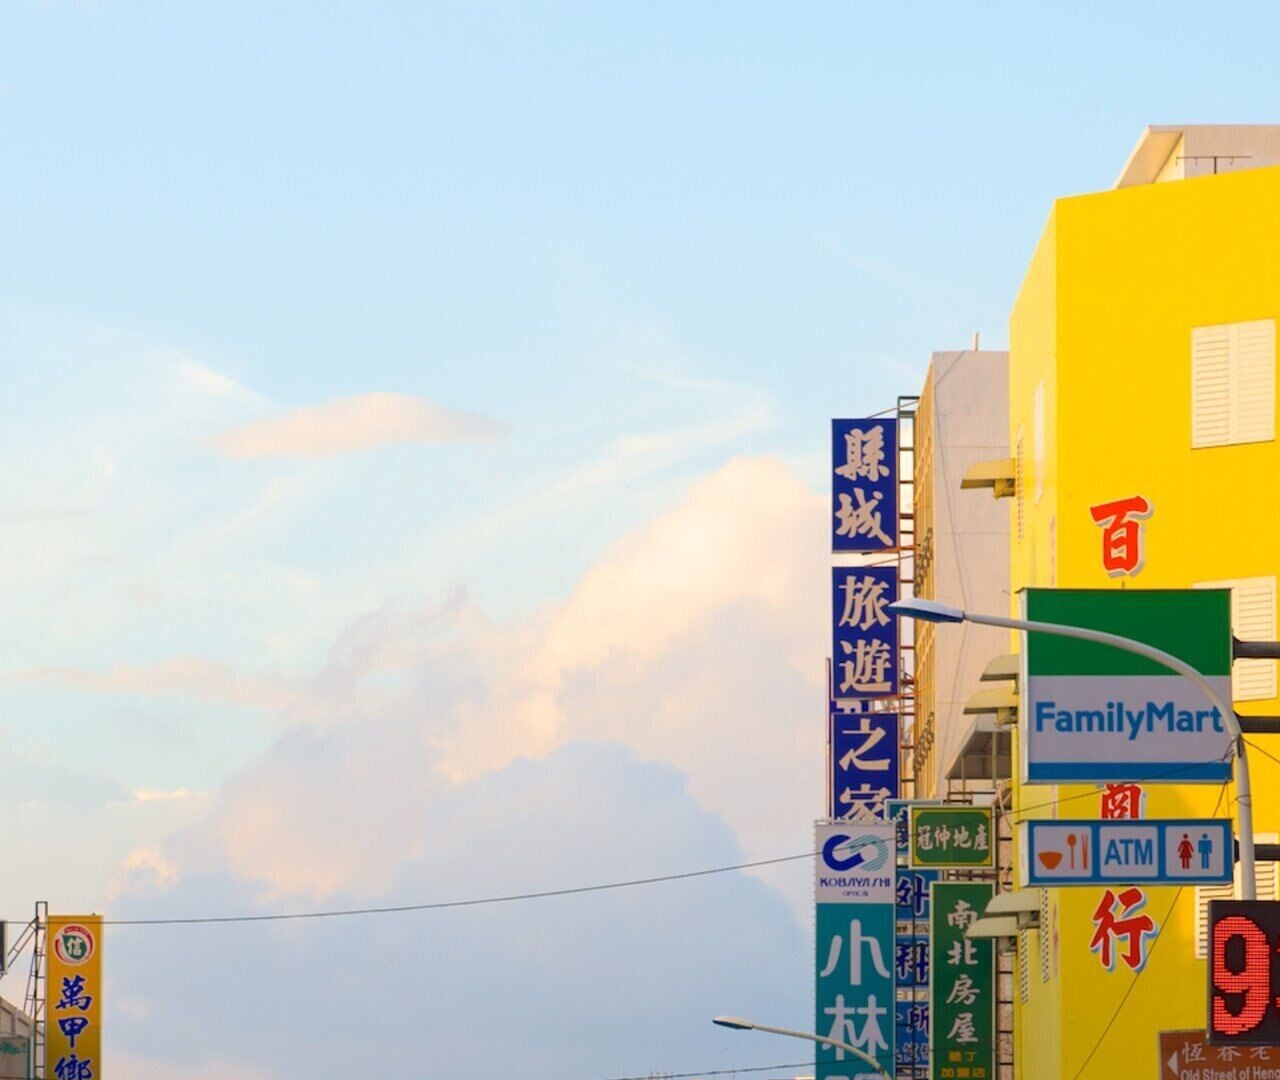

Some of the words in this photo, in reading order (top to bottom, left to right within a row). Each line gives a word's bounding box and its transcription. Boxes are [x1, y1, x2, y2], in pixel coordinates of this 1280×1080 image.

[1035, 701, 1224, 740] FamilyMart
[1104, 838, 1154, 867] ATM
[946, 899, 982, 1045] 南北房屋
[1239, 1066, 1251, 1080] of
